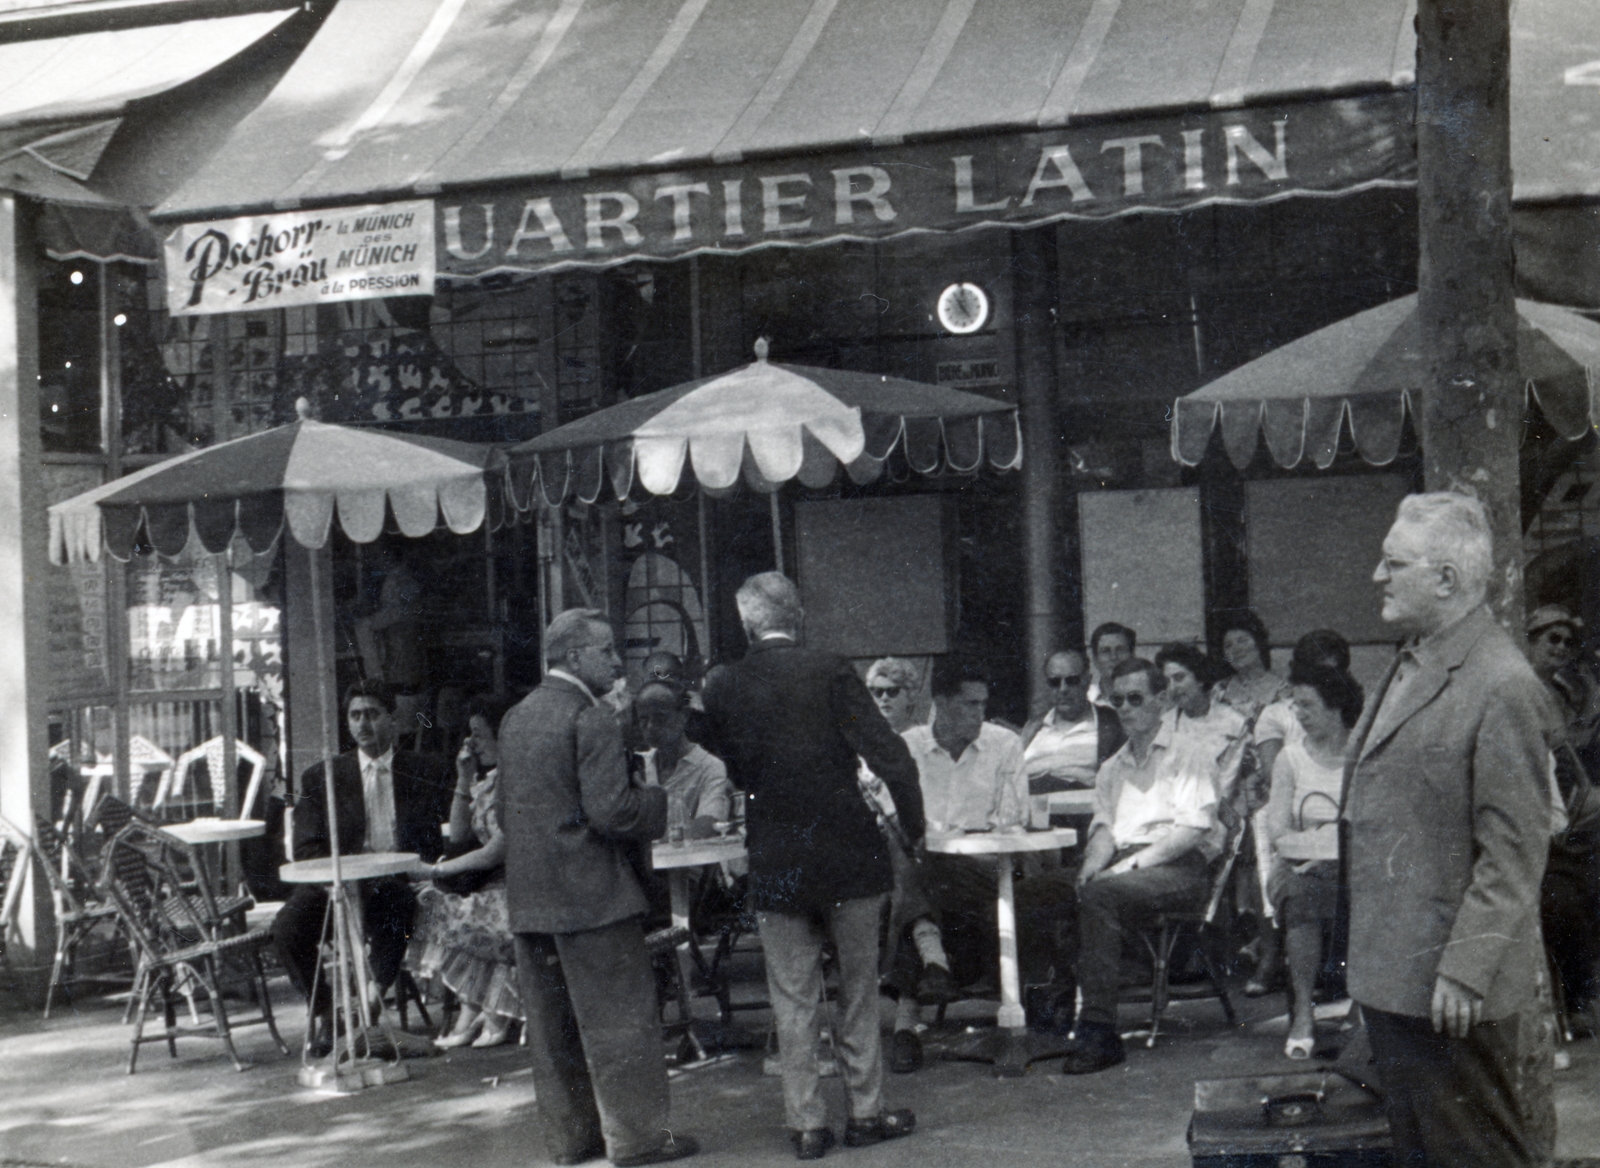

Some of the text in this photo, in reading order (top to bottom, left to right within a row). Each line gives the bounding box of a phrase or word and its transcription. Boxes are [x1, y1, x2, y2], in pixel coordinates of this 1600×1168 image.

[442, 119, 1289, 261] UARTIER LATIN
[337, 211, 415, 235] la MÜNICH
[336, 243, 418, 269] MÜNICH
[332, 281, 344, 293] la
[349, 273, 420, 292] PRESSION
